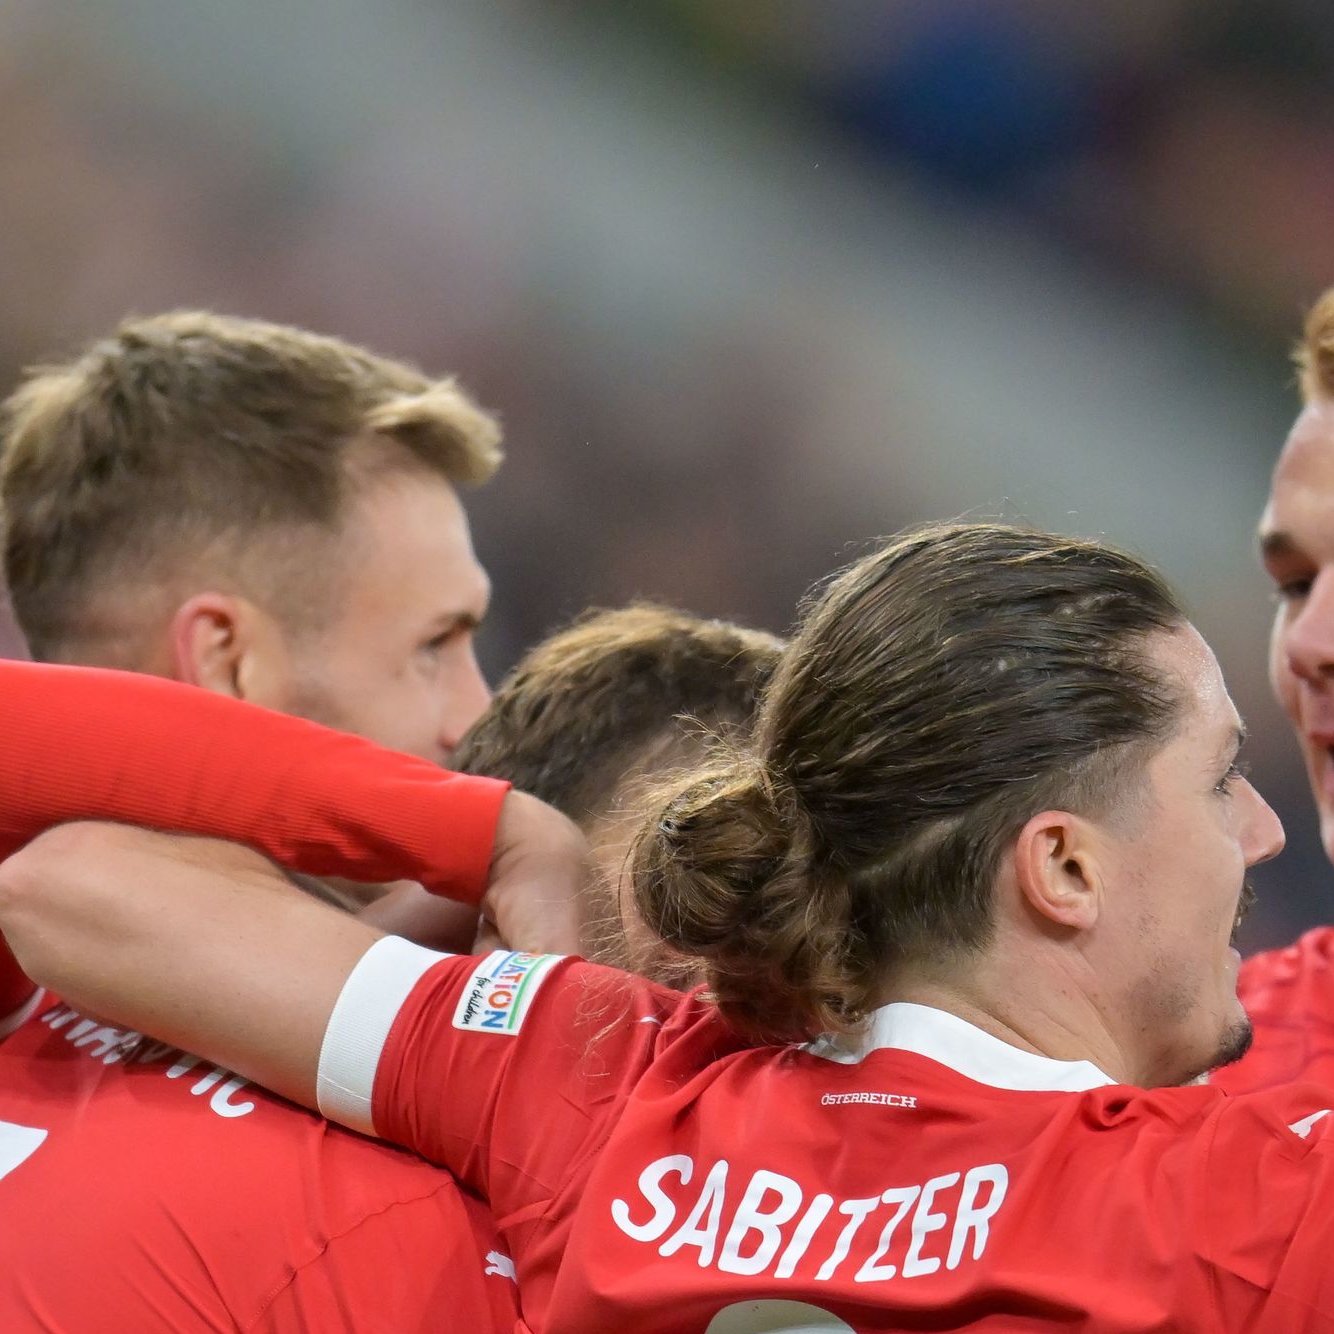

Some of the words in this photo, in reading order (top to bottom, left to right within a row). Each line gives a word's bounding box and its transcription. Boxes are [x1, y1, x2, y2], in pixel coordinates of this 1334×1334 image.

[461, 989, 483, 1025] children
[480, 952, 543, 1028] DATION
[821, 1093, 917, 1108] ÖSTERREICH
[610, 1154, 1009, 1282] SABITZER
